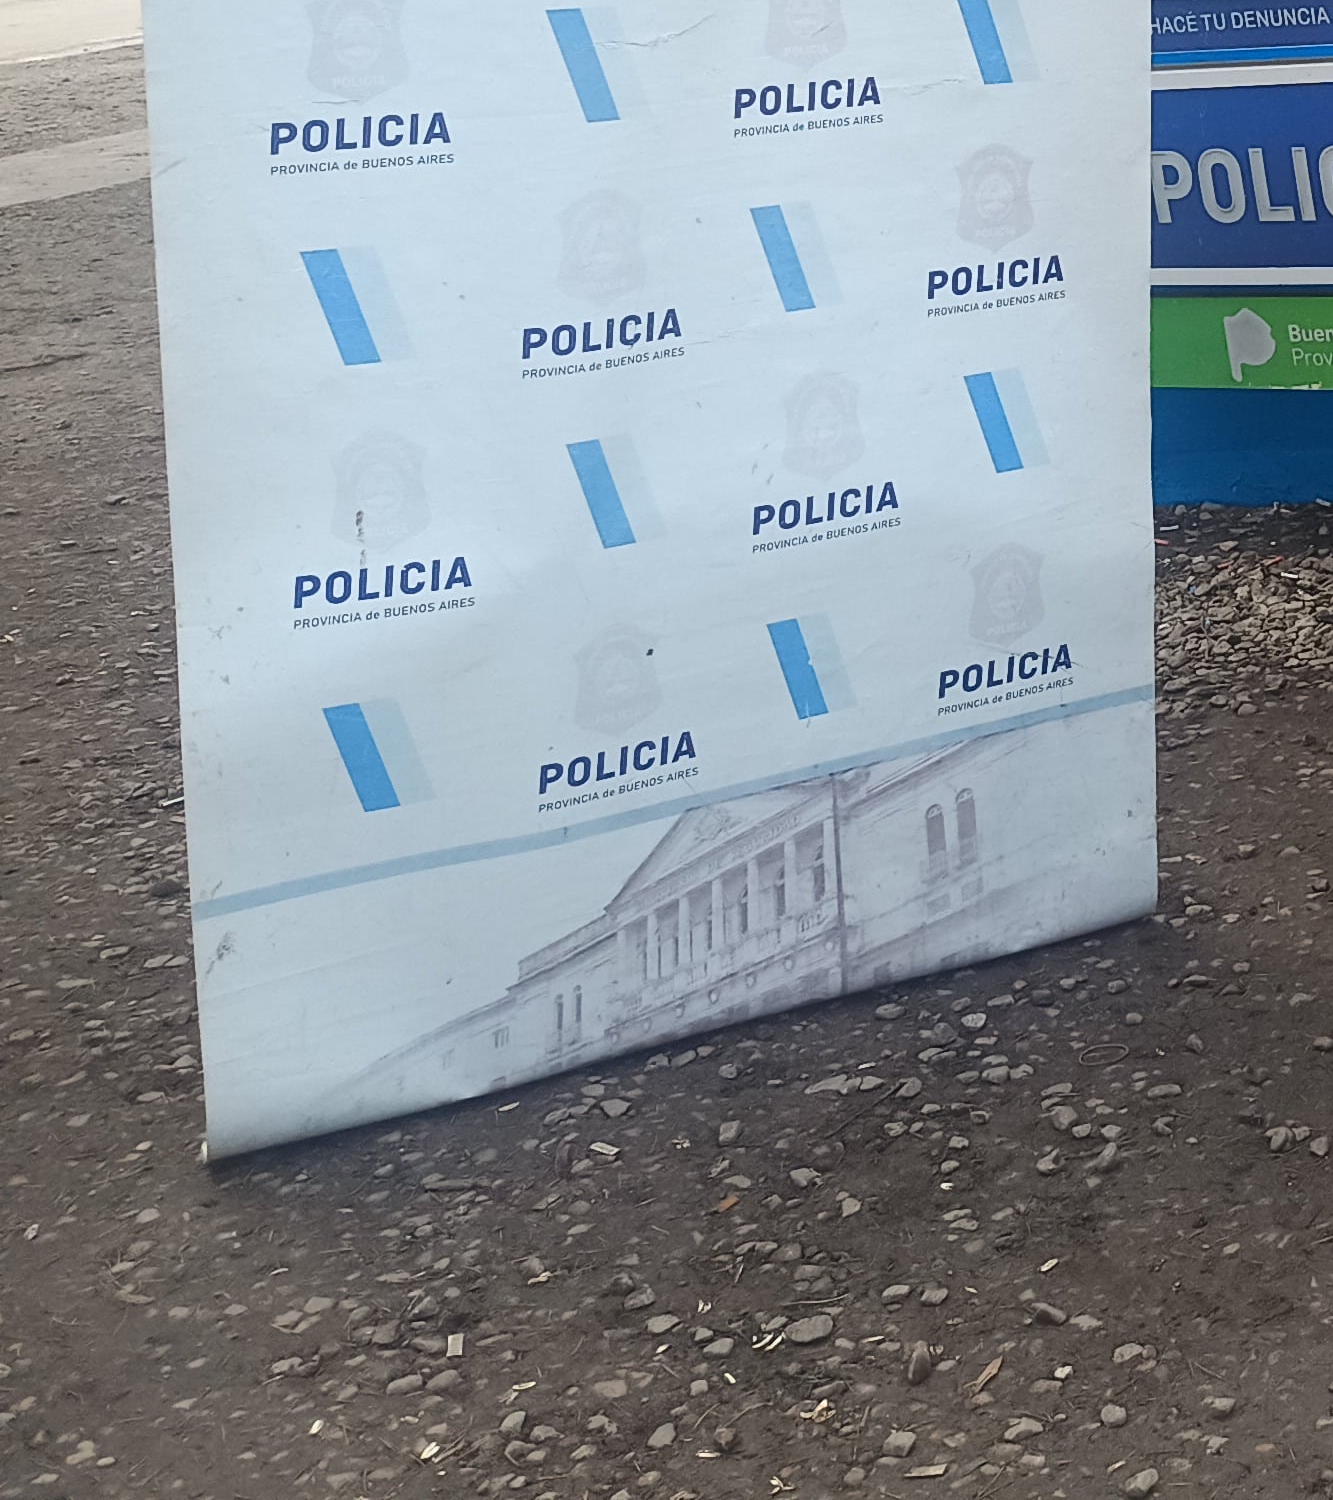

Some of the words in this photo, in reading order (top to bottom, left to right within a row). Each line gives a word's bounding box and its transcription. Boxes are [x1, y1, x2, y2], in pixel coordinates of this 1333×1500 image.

[1200, 12, 1226, 31] TU
[1231, 7, 1331, 29] DENUNCIA
[733, 76, 881, 120] POLICIA
[270, 111, 452, 156] POLICIA
[733, 123, 790, 138] PROVINCIA
[792, 122, 805, 132] de
[807, 117, 850, 131] BUENOS
[852, 113, 884, 125] AIRES
[270, 161, 340, 176] PROVINCIA
[343, 160, 358, 171] de
[361, 155, 414, 169] BUENOS
[416, 153, 455, 165] AIRES
[927, 254, 1064, 300] POLICIA
[927, 302, 980, 318] PROVINCIA
[982, 301, 994, 310] de
[996, 294, 1036, 308] BUENOS
[1037, 289, 1066, 302] AIRES
[521, 308, 682, 360] POLICIA
[522, 363, 587, 380] PROVINCIA
[588, 362, 602, 372] de
[605, 352, 650, 369] BUENOS
[652, 346, 685, 361] AIRES
[752, 481, 899, 536] POLICIA
[752, 535, 809, 554] PROVINCIA
[811, 533, 824, 543] de
[826, 523, 869, 540] BUENOS
[870, 516, 901, 532] AIRES
[293, 556, 473, 609] POLICIA
[293, 612, 362, 630] PROVINCIA
[365, 610, 380, 621] de
[384, 602, 436, 618] BUENOS
[438, 596, 476, 611] AIRES
[938, 643, 1073, 700] POLICIA
[937, 697, 990, 717] PROVINCIA
[991, 695, 1004, 704] de
[1005, 683, 1045, 701] BUENOS
[1045, 676, 1074, 691] AIRES
[538, 731, 697, 795] POLICIA
[538, 791, 600, 813] PROVINCIA
[602, 788, 616, 798] de
[618, 775, 664, 795] BUENOS
[666, 766, 699, 783] AIRES
